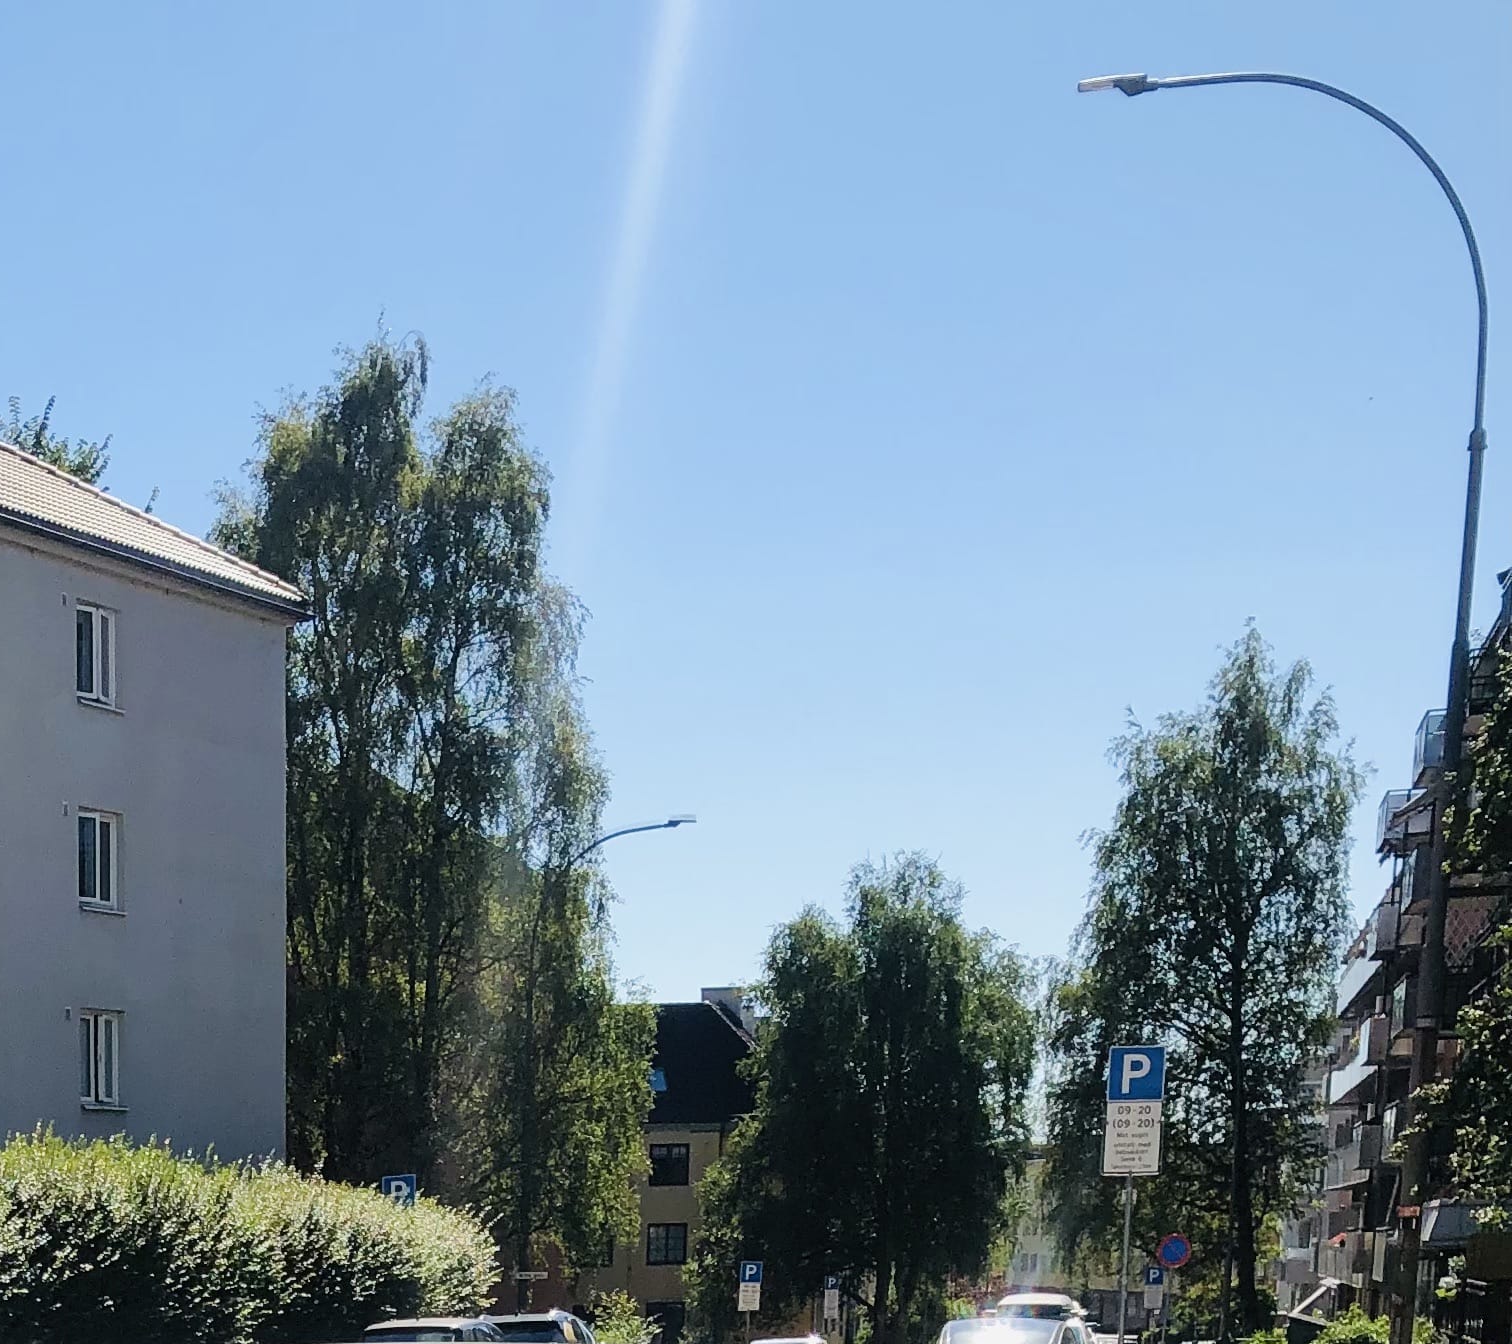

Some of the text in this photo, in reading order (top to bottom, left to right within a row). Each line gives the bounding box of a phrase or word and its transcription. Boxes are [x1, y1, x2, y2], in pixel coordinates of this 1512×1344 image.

[1121, 1054, 1151, 1094] P
[390, 1180, 407, 1203] P
[745, 1264, 757, 1281] P
[1149, 1269, 1160, 1282] P
[828, 1277, 837, 1288] P
